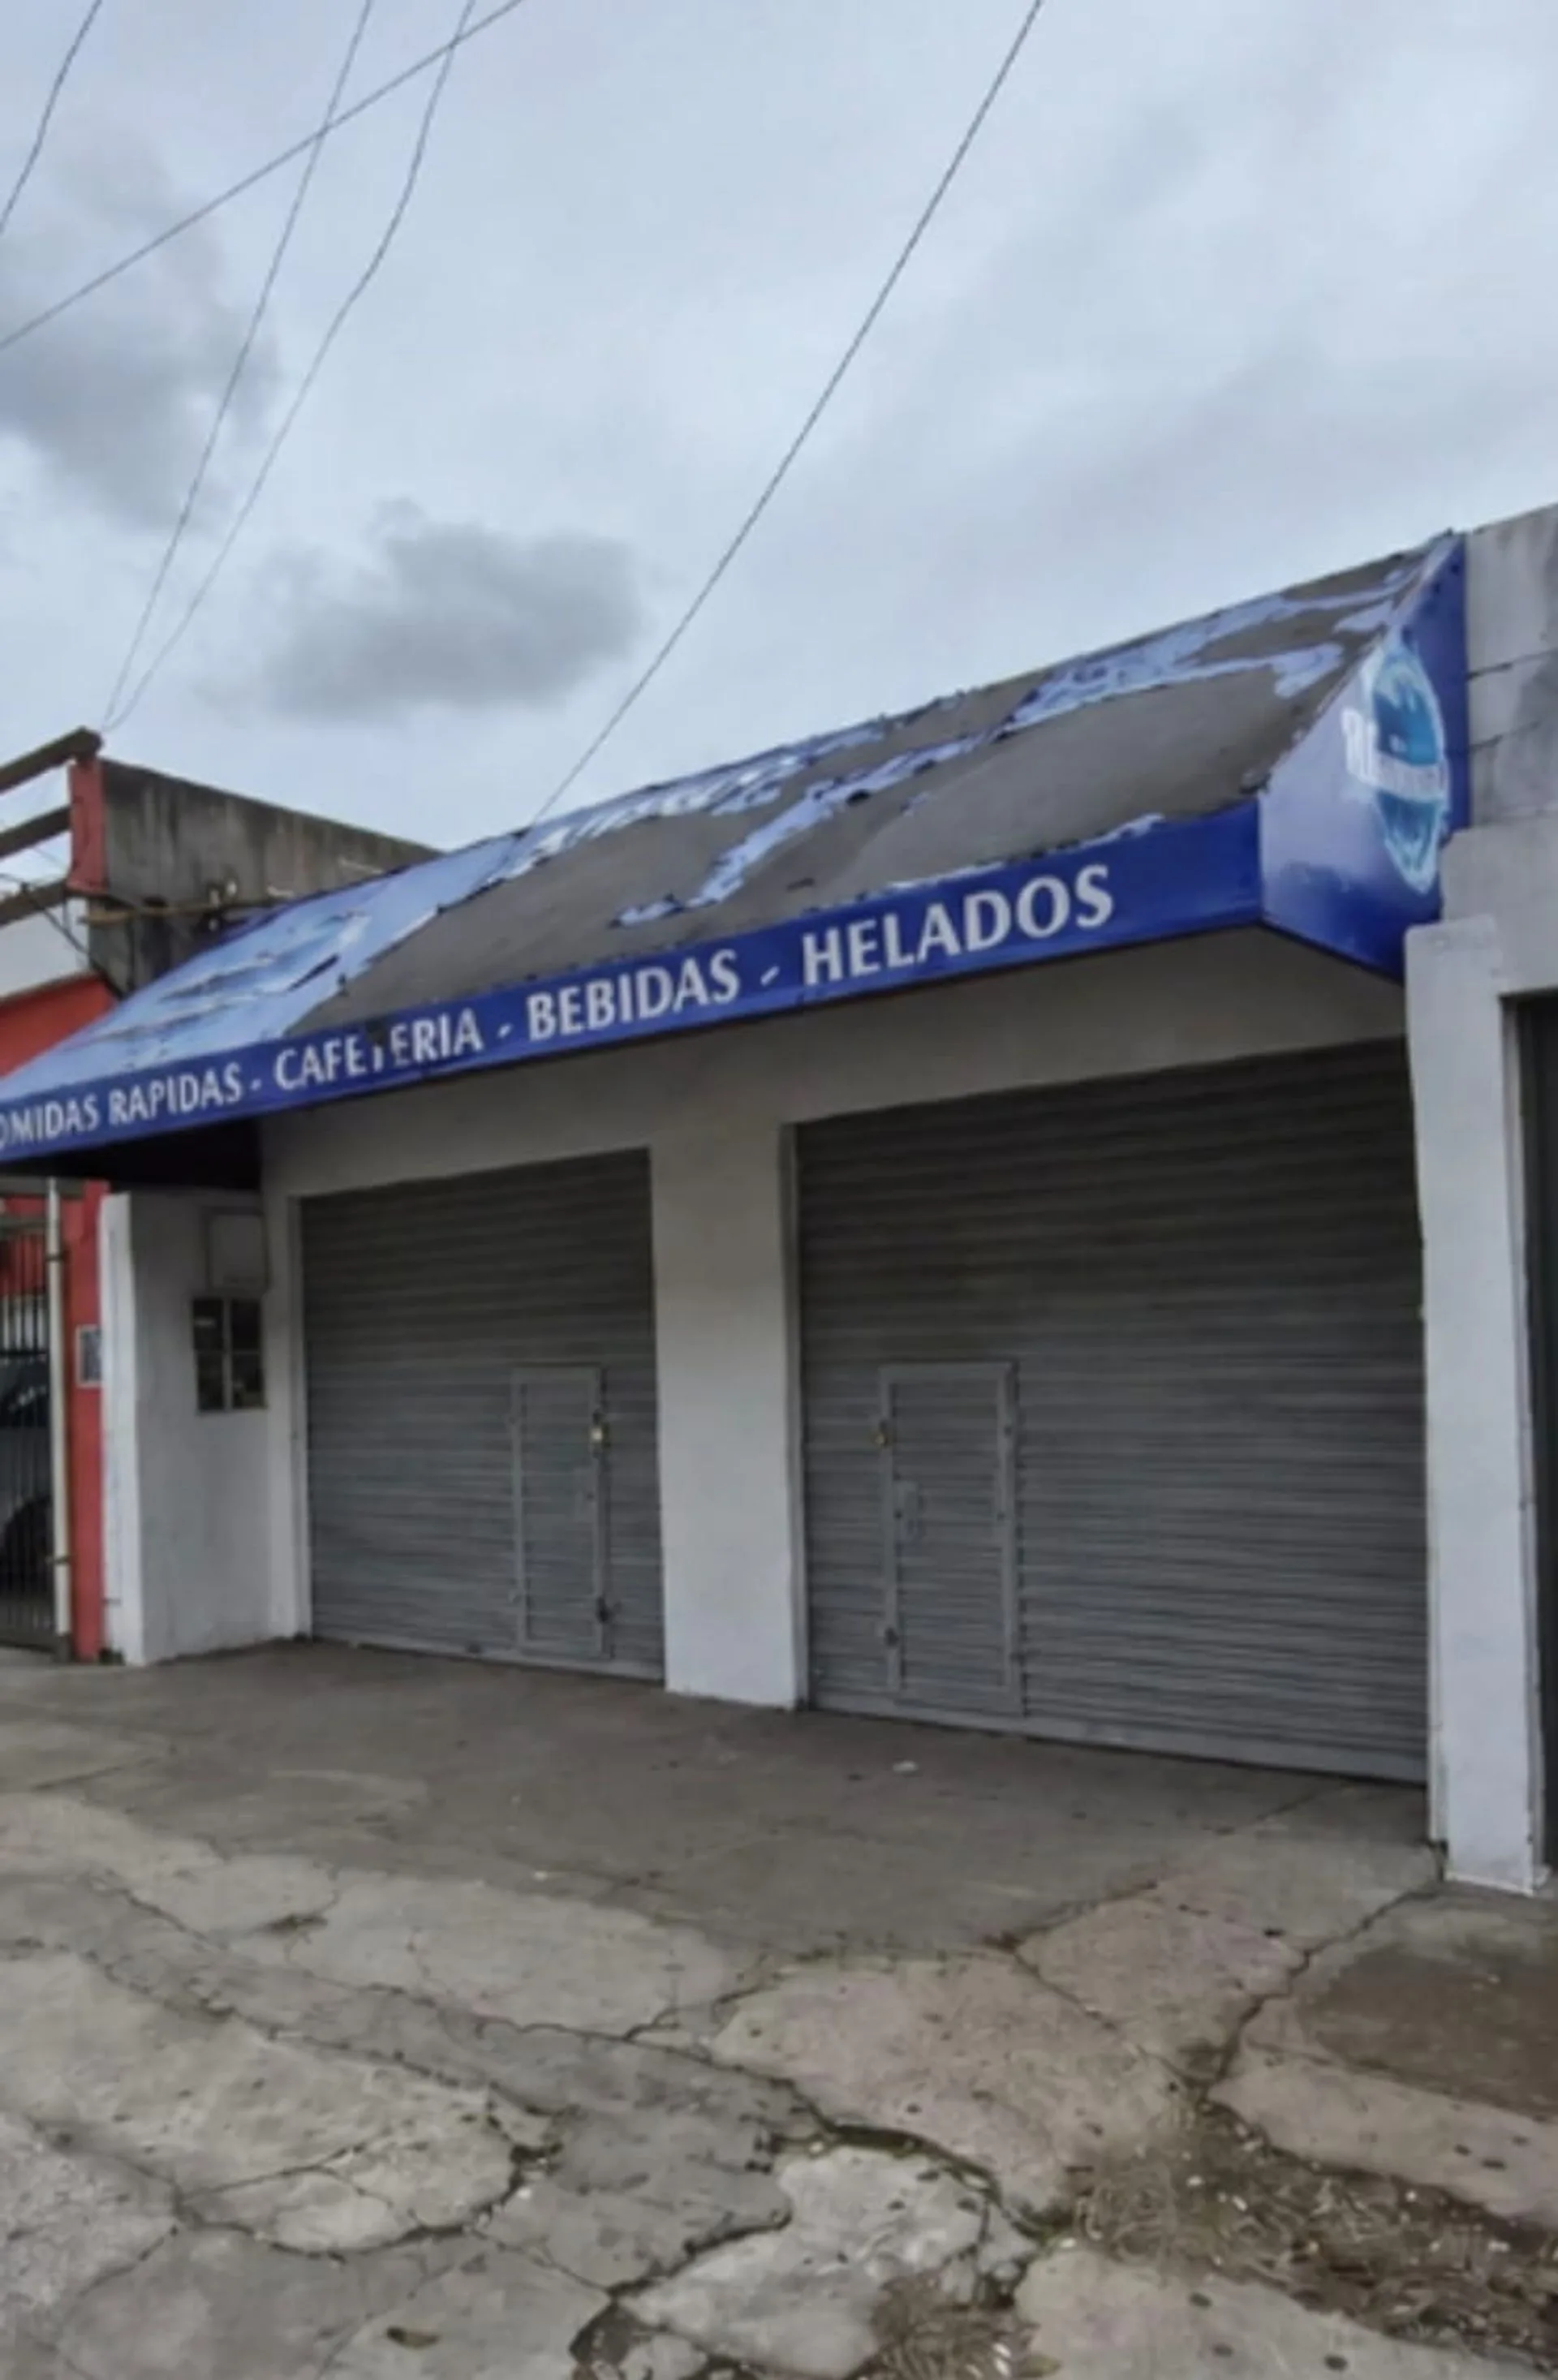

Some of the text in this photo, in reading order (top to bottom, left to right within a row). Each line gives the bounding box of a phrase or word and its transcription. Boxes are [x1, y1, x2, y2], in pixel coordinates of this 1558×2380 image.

[108, 1062, 243, 1125] RAPIDAS
[527, 949, 739, 1040] BEBIDAS
[803, 865, 1113, 985] HELADOS
